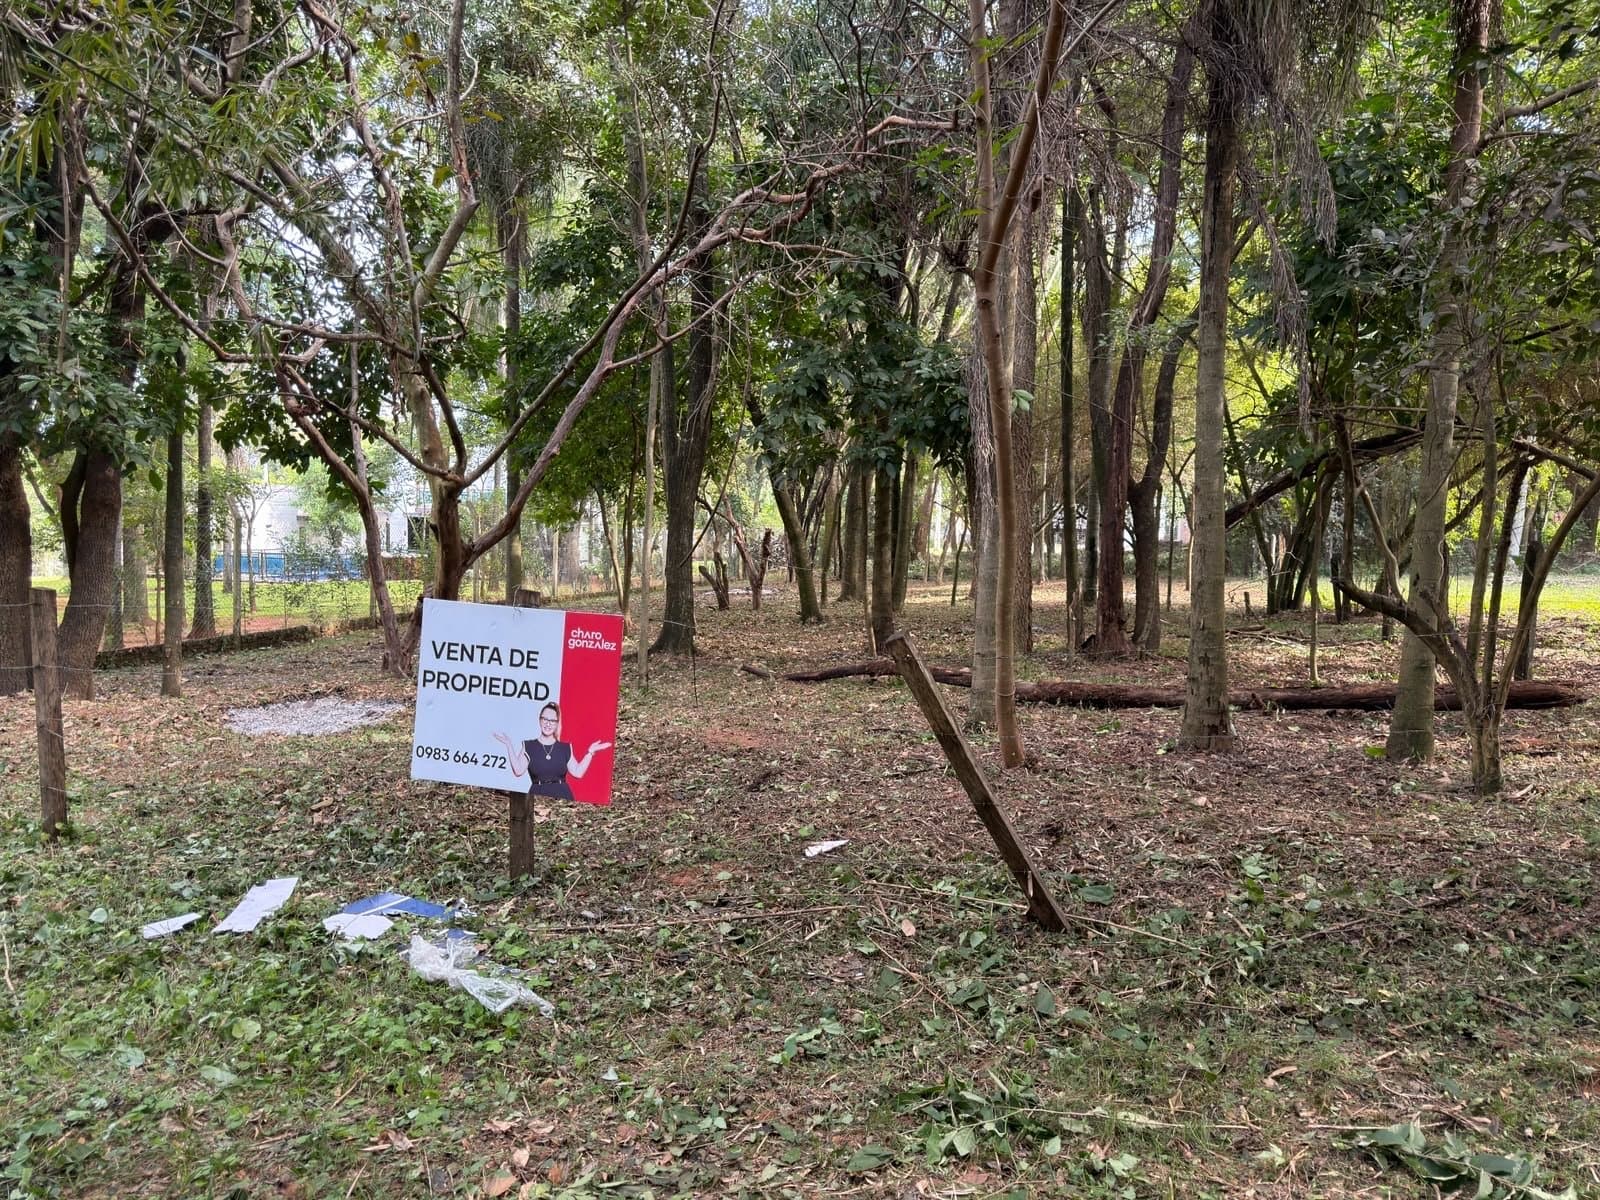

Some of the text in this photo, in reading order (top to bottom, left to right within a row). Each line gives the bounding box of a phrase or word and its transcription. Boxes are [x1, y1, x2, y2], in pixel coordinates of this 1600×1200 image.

[567, 637, 617, 651] gonzalez
[570, 627, 602, 640] charo
[431, 640, 540, 670] VENTA DE
[422, 669, 550, 702] PROPIEDAD
[415, 745, 507, 770] 0983 664 272
